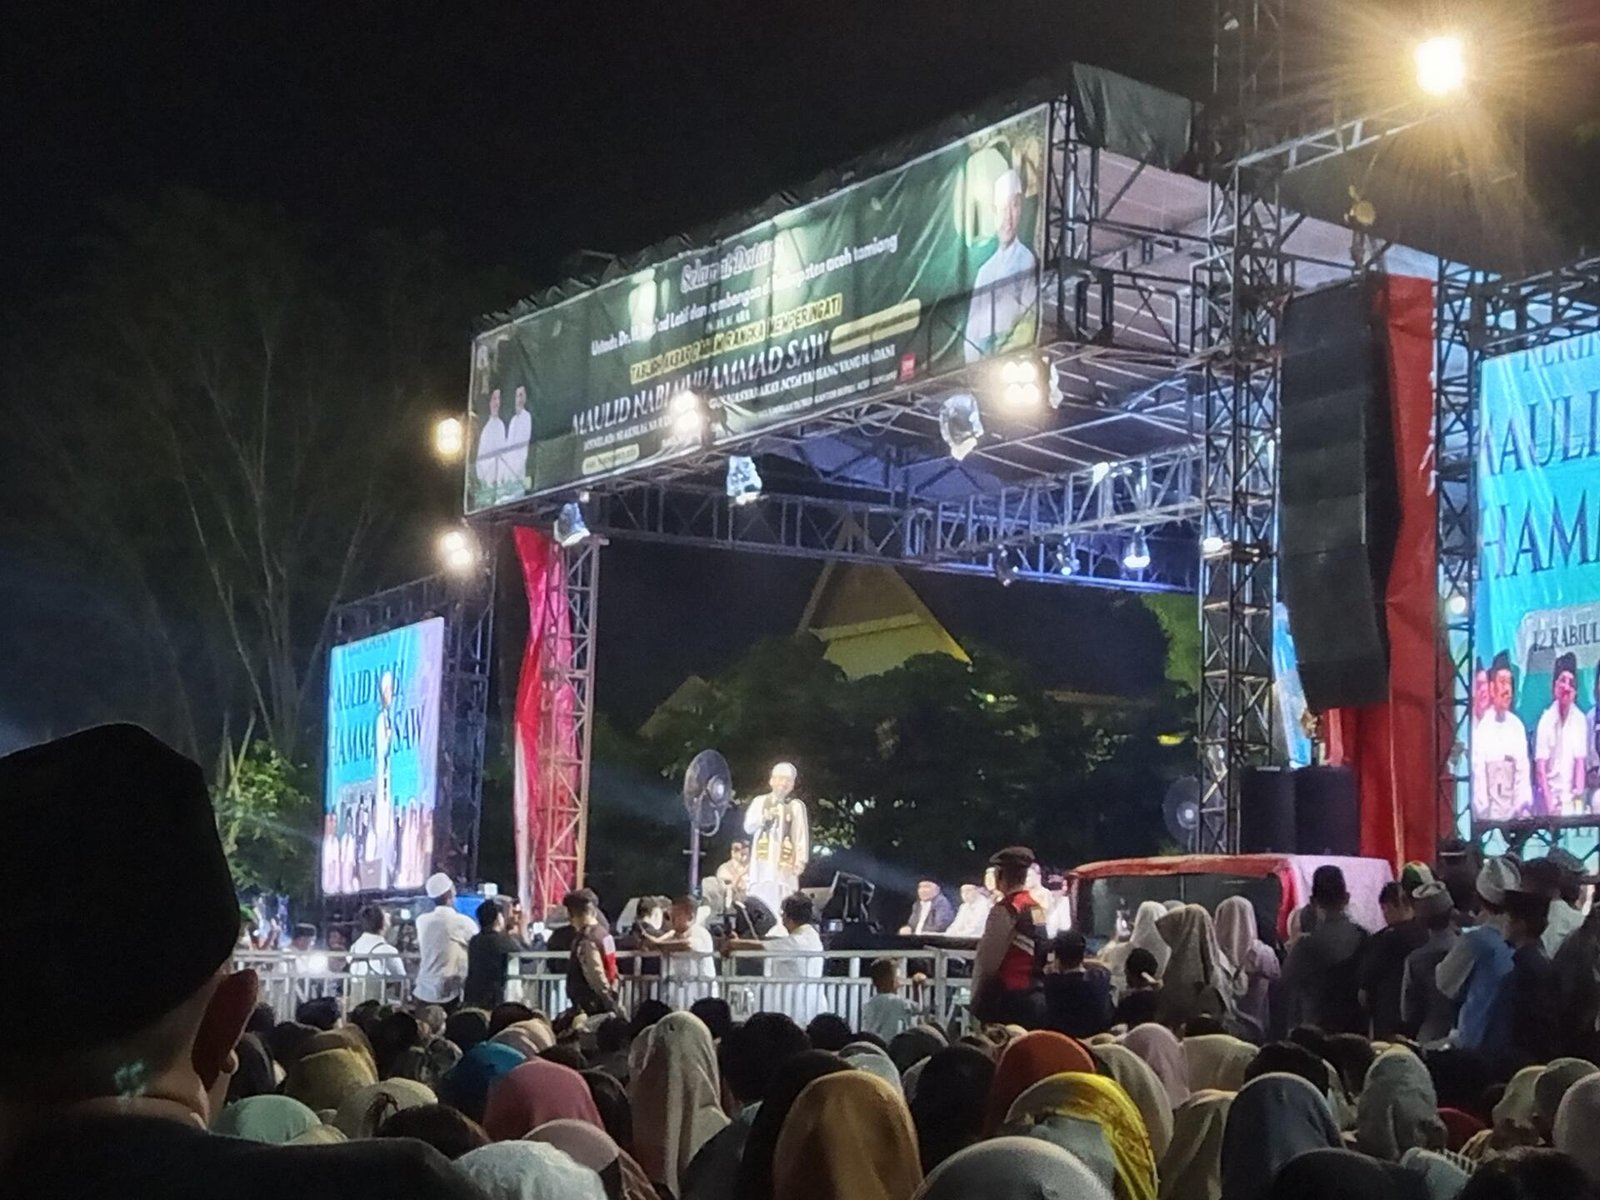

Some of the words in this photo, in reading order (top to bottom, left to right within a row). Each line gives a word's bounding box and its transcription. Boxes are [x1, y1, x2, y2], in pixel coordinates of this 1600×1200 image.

[572, 396, 631, 435] MAULID
[633, 382, 670, 419] NABI
[786, 330, 829, 370] SAW
